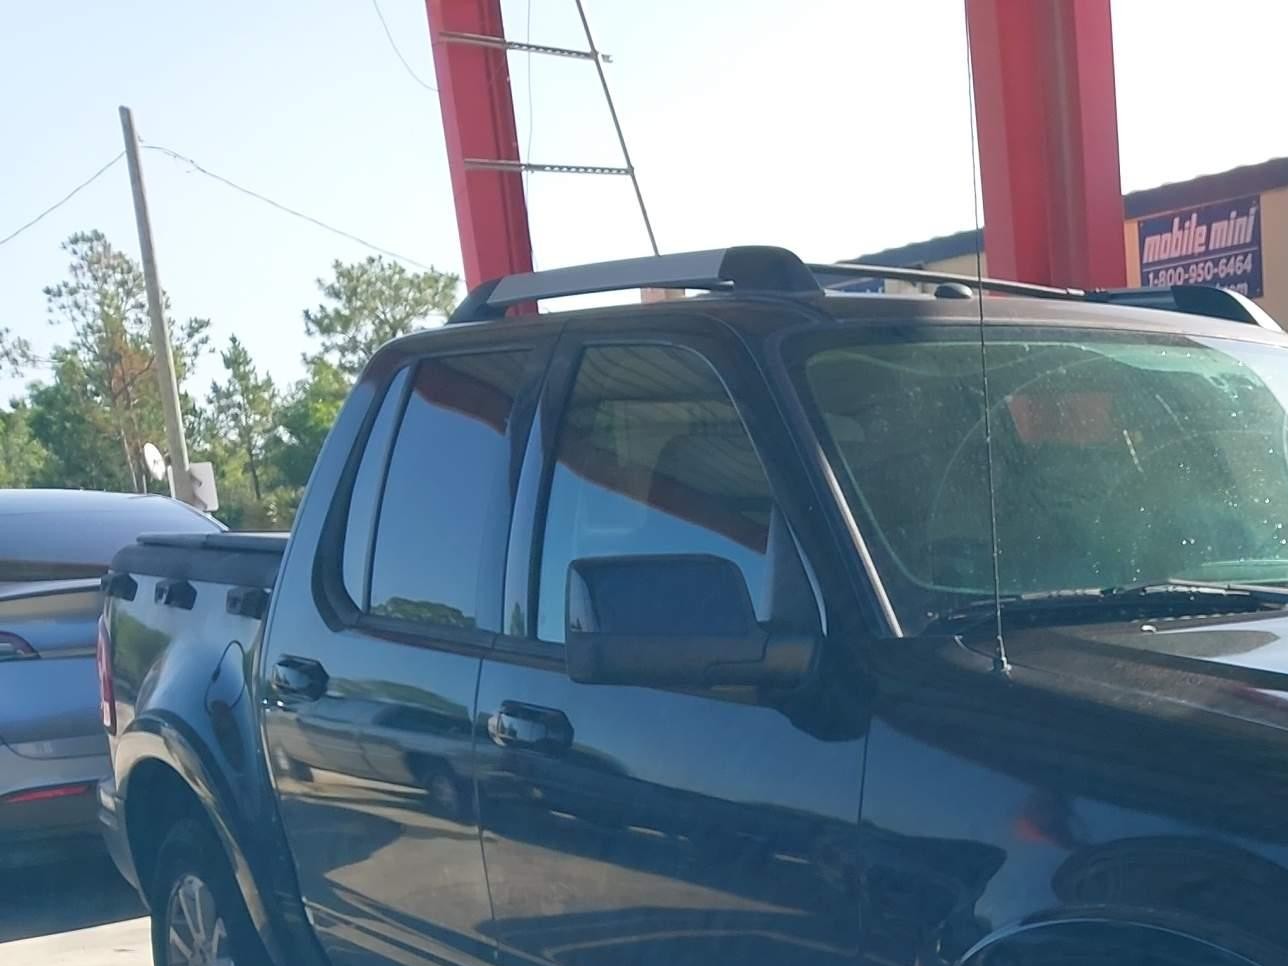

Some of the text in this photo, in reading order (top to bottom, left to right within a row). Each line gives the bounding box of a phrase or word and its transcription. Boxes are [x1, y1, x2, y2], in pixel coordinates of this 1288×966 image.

[1142, 206, 1257, 264] mobile mini
[1148, 253, 1252, 287] 1-800-950-6464
